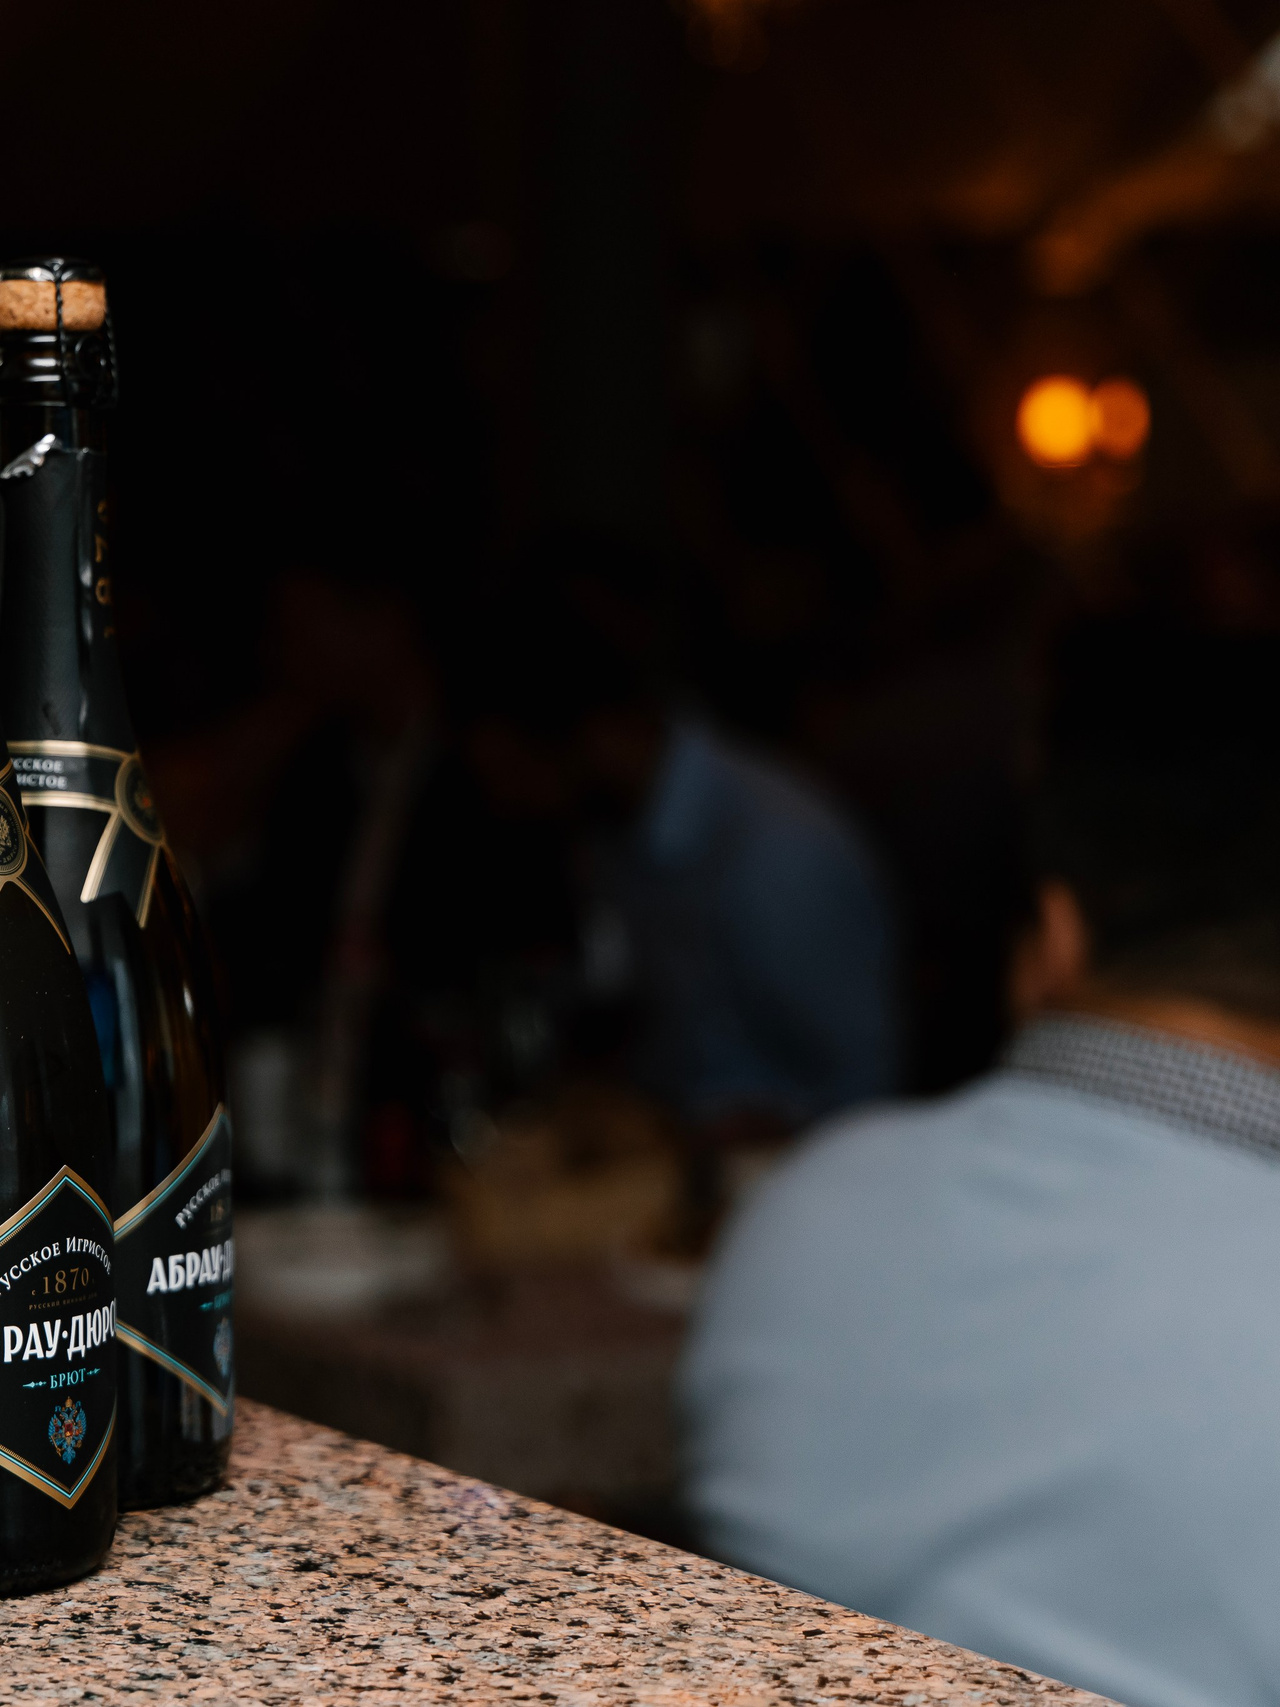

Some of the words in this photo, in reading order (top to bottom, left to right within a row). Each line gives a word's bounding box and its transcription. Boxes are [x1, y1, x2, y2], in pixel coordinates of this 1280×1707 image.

[13, 757, 65, 774] ССКОЕ
[17, 773, 68, 790] ИСТОЕ
[43, 1267, 90, 1294] 1870
[50, 1368, 86, 1389] БРЮТ
